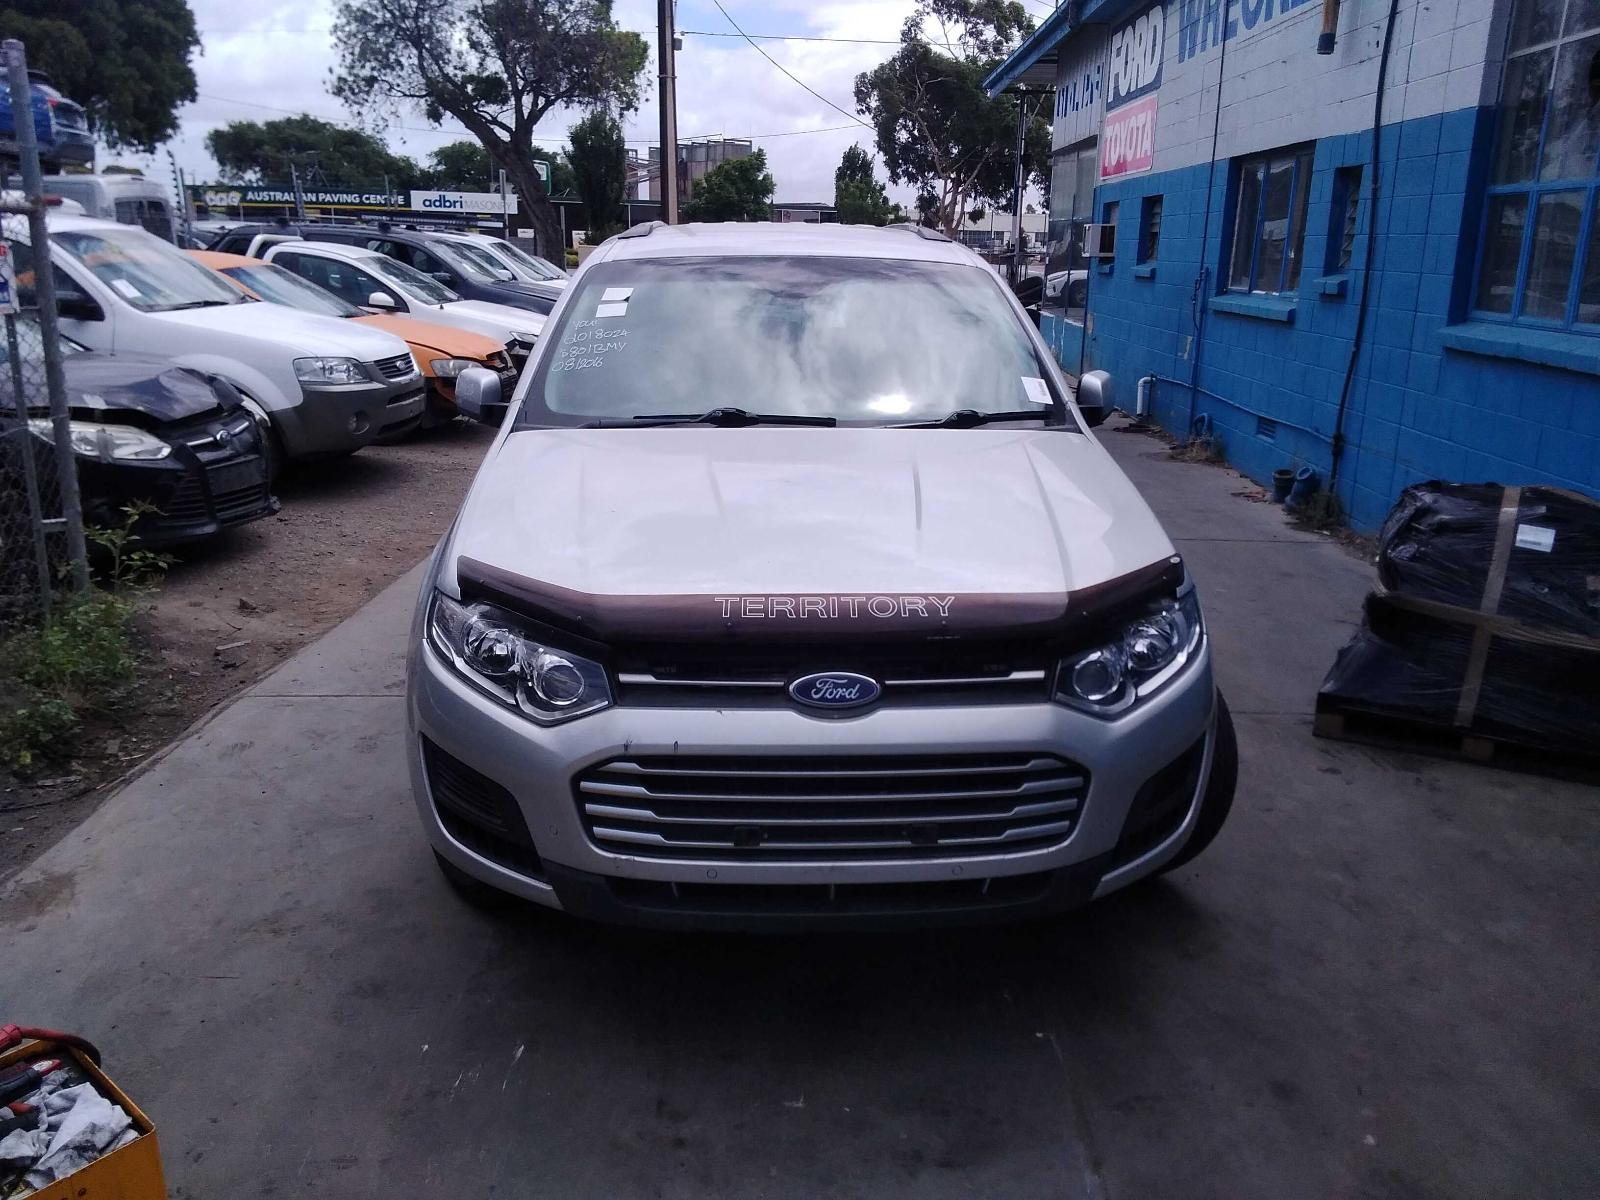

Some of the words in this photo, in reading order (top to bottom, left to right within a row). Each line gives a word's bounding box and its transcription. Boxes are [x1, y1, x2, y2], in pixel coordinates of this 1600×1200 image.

[1108, 5, 1163, 103] FORD
[1104, 111, 1152, 168] TOYOTA
[318, 192, 361, 204] PAVING
[423, 193, 463, 209] adbri
[714, 596, 955, 618] TERRITORY
[811, 678, 859, 700] Ford
